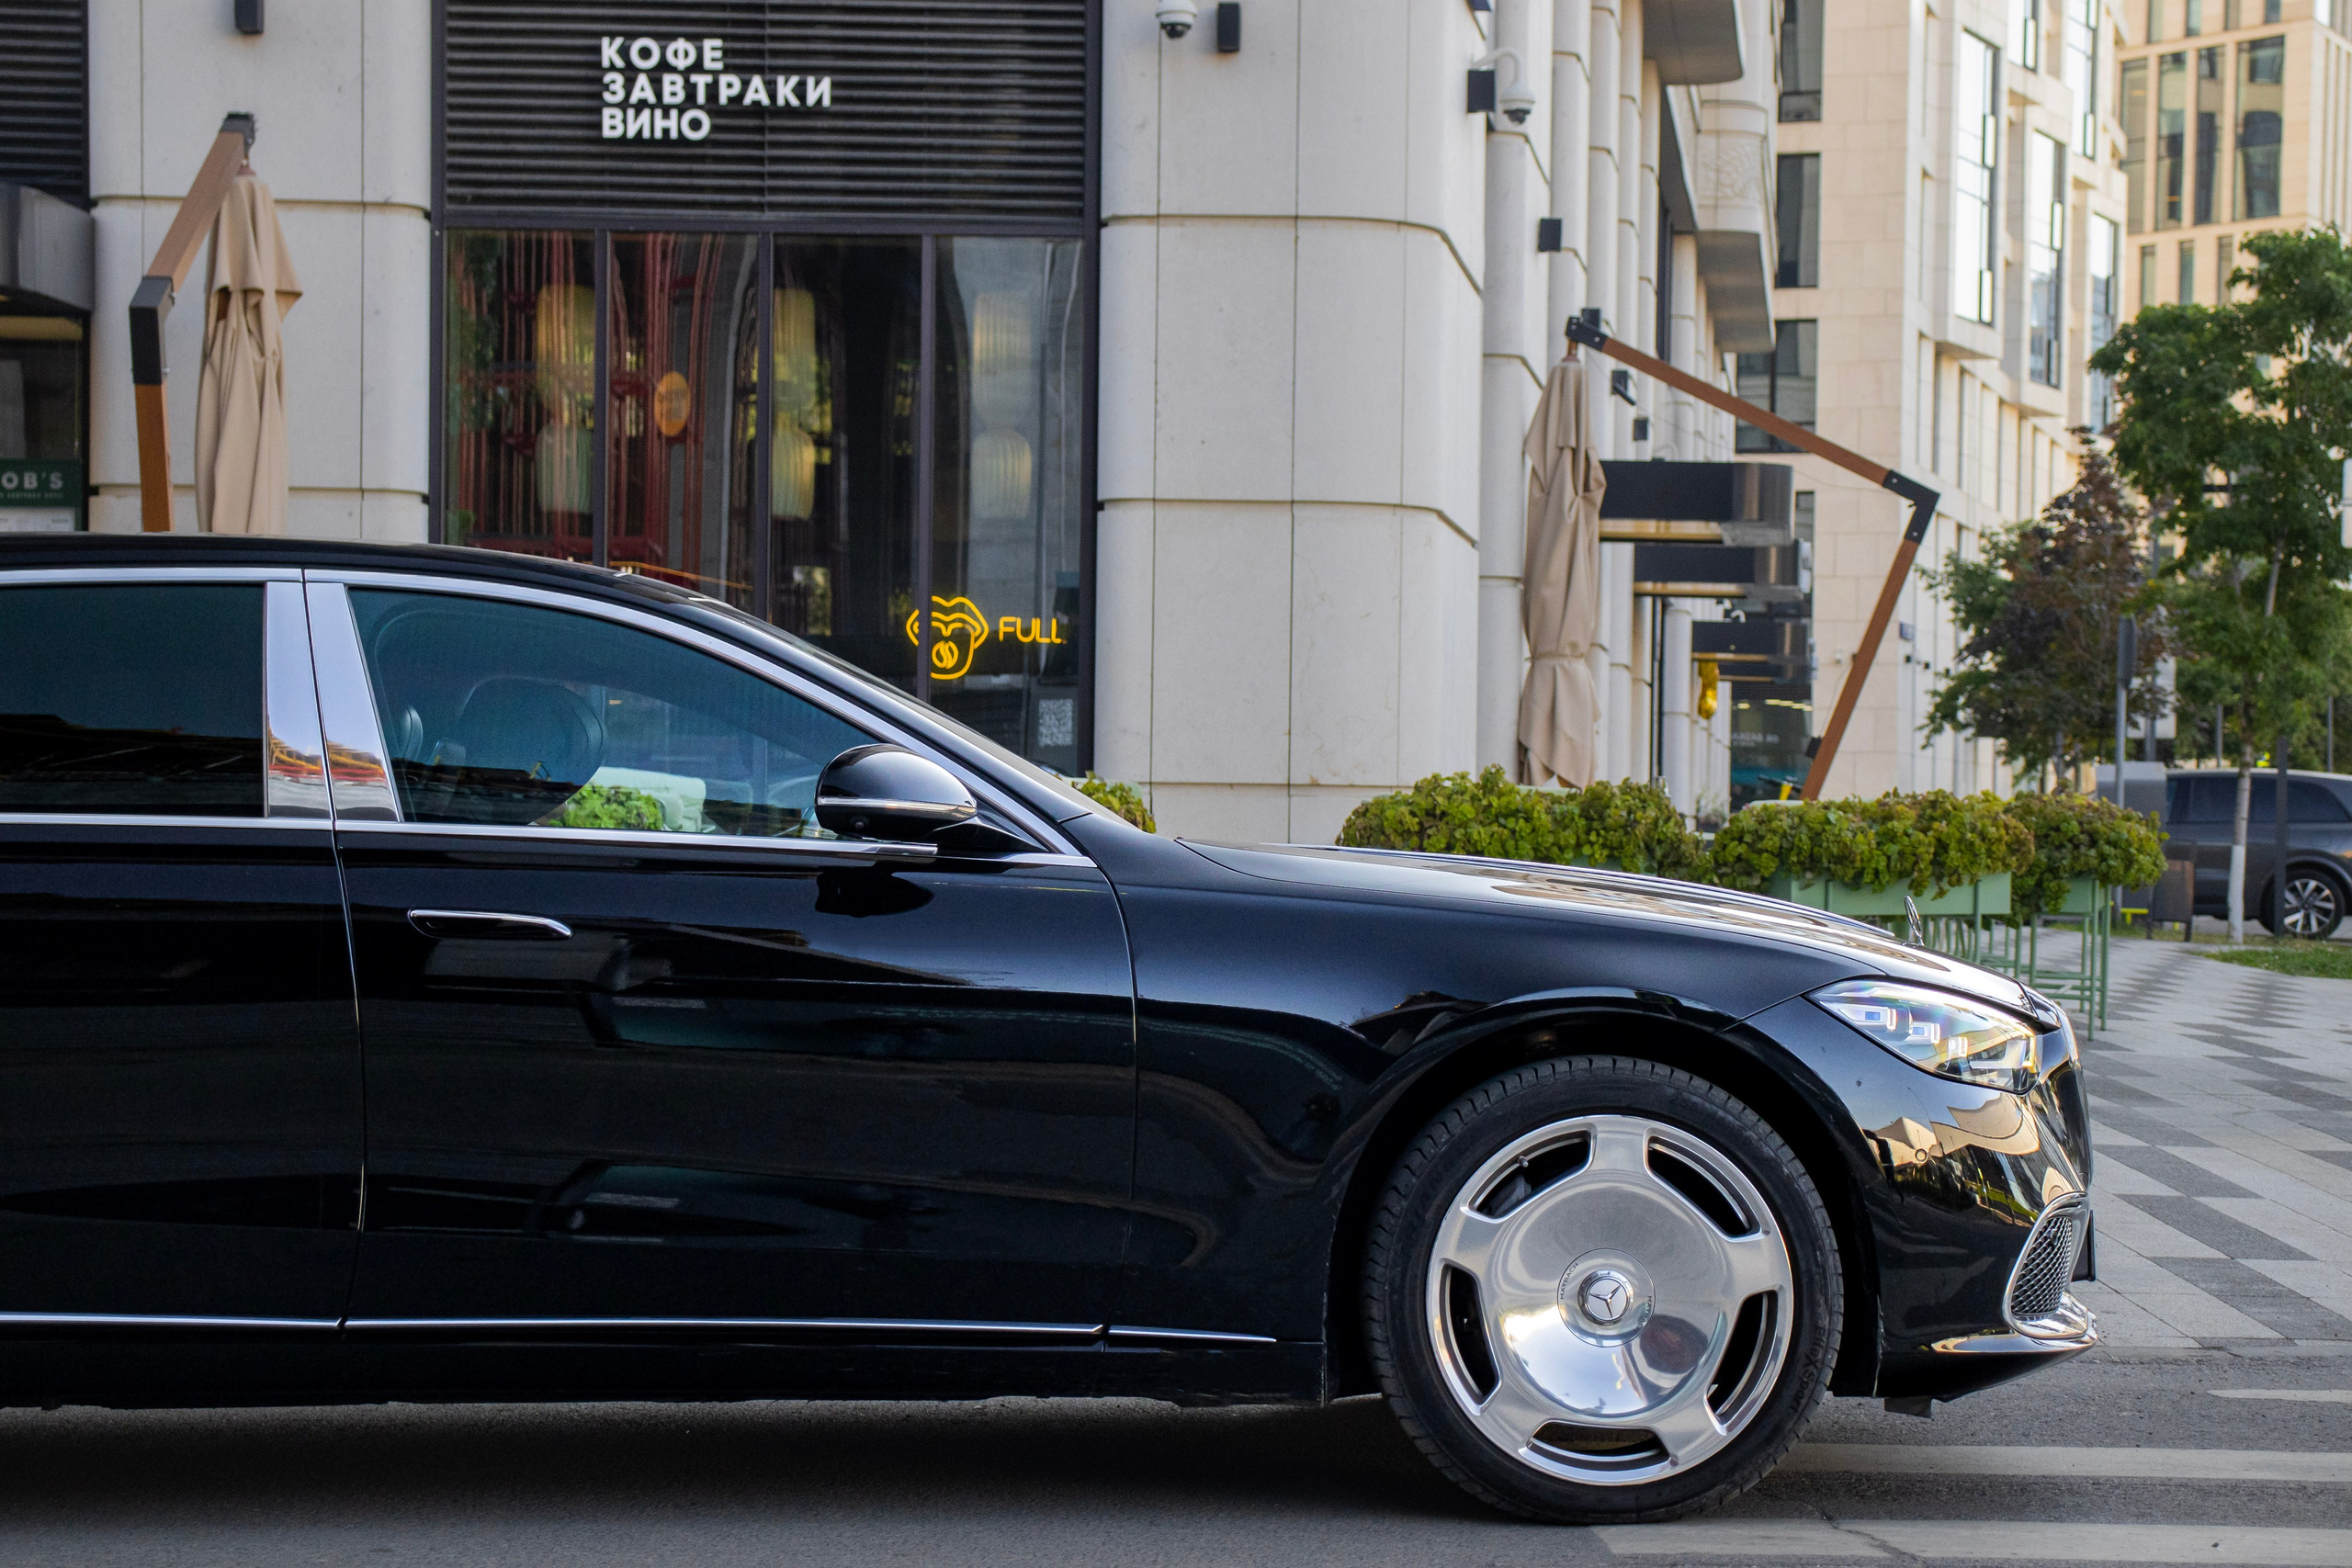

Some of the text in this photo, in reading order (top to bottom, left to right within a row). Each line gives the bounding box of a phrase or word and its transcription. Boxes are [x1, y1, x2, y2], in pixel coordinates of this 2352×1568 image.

[601, 37, 724, 71] КОФЕ
[602, 72, 831, 107] ЗАВТРАКИ
[602, 107, 711, 141] ВИНО
[999, 617, 1063, 643] FULL
[1560, 1262, 1579, 1300] MAYBACH
[1635, 1295, 1652, 1331] MAYBAC
